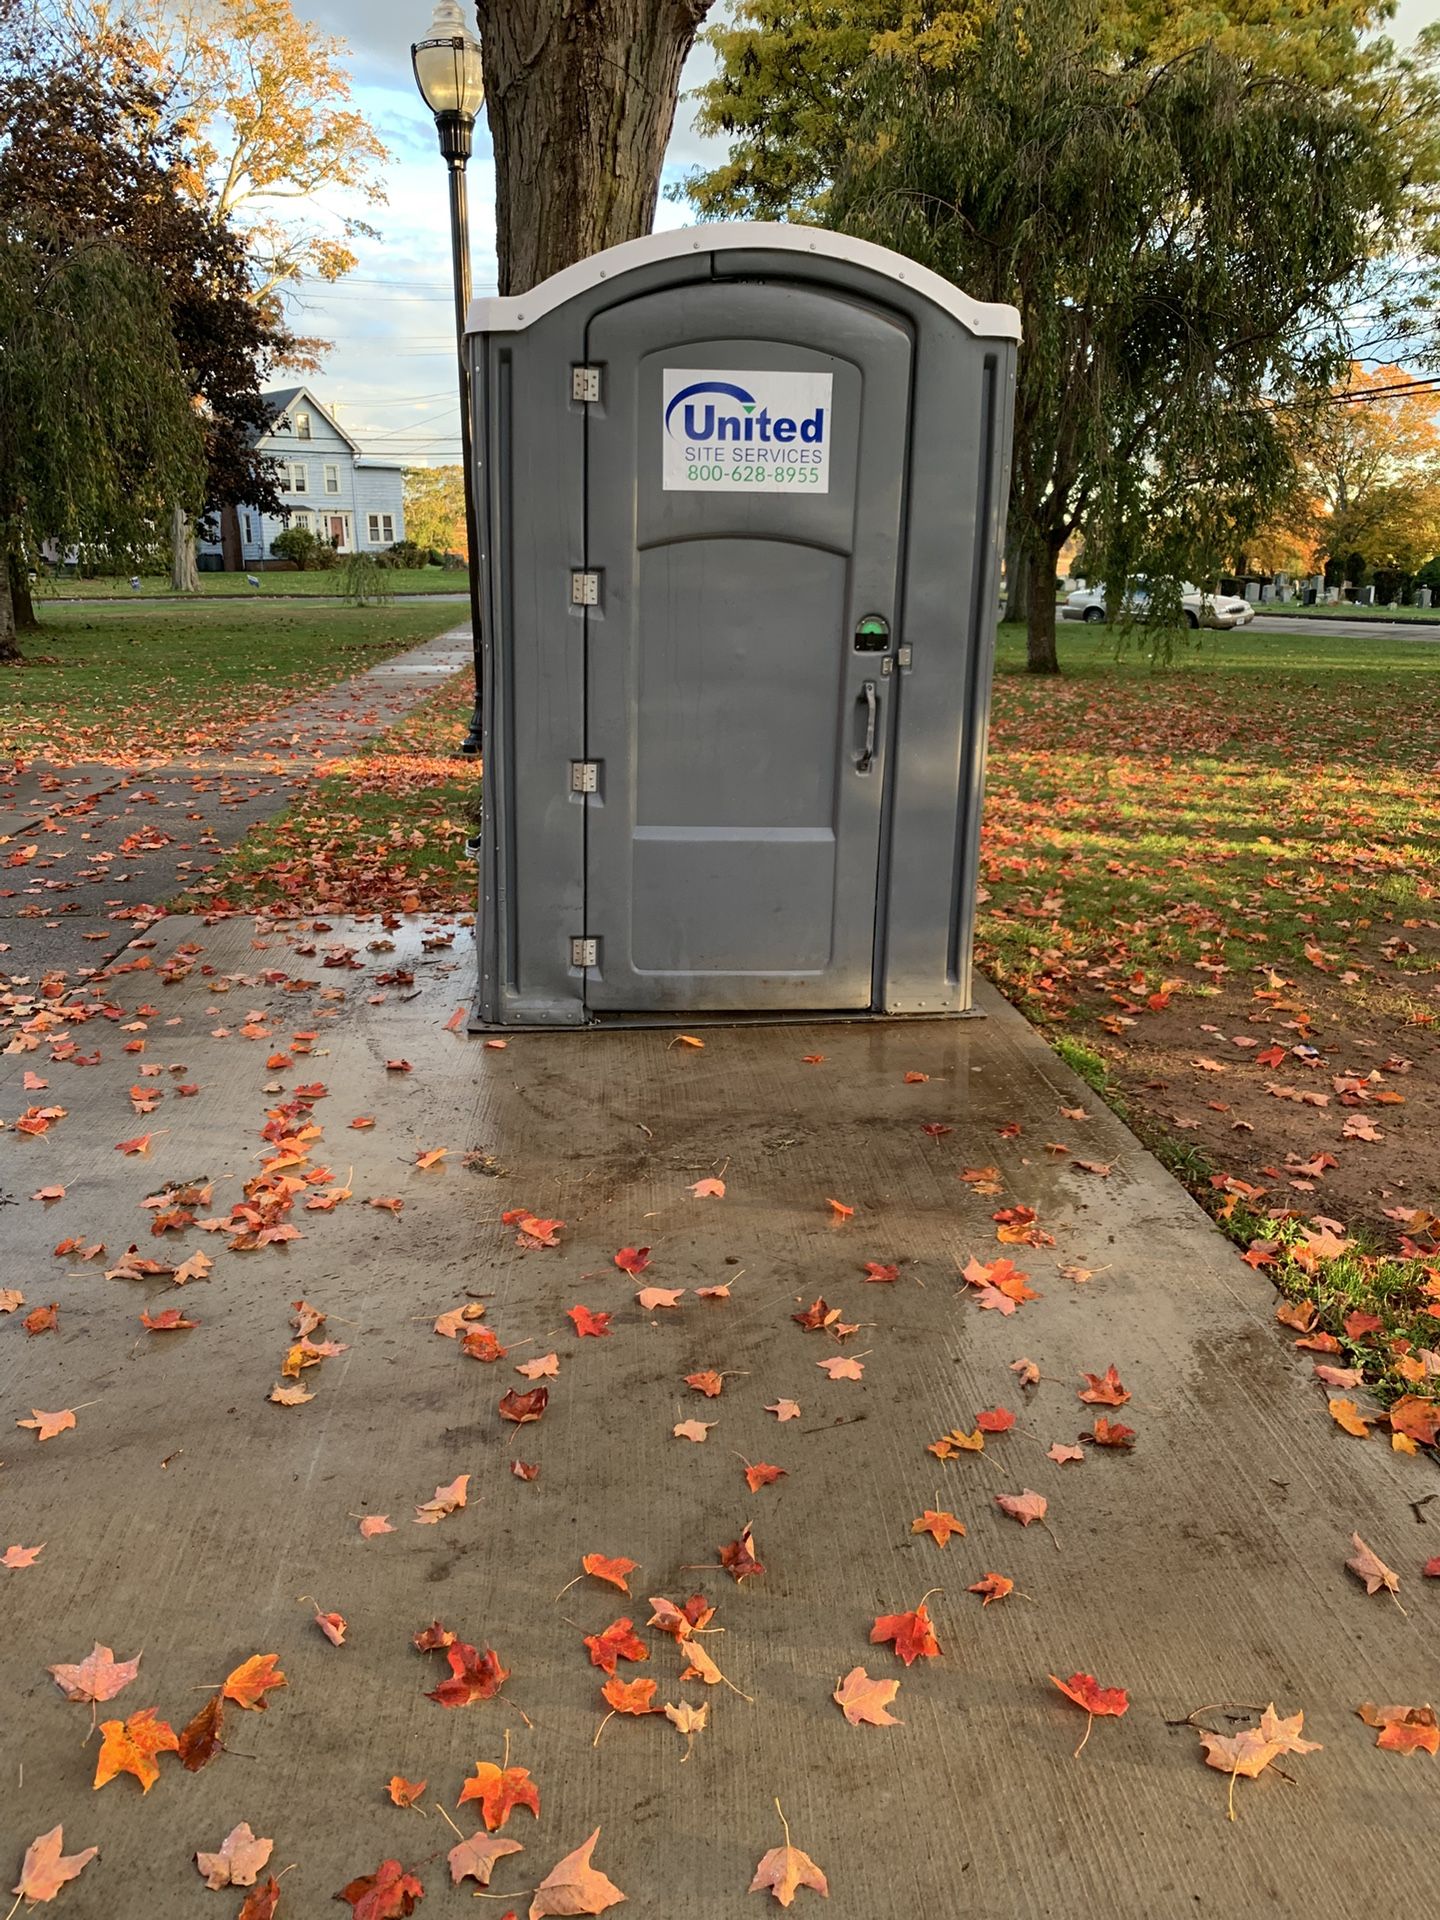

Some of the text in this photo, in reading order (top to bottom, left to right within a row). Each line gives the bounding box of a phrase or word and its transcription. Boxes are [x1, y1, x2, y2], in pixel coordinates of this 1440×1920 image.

[684, 404, 824, 443] United
[685, 447, 822, 464] SITE SERVICES
[687, 465, 819, 483] 800-628-8955
